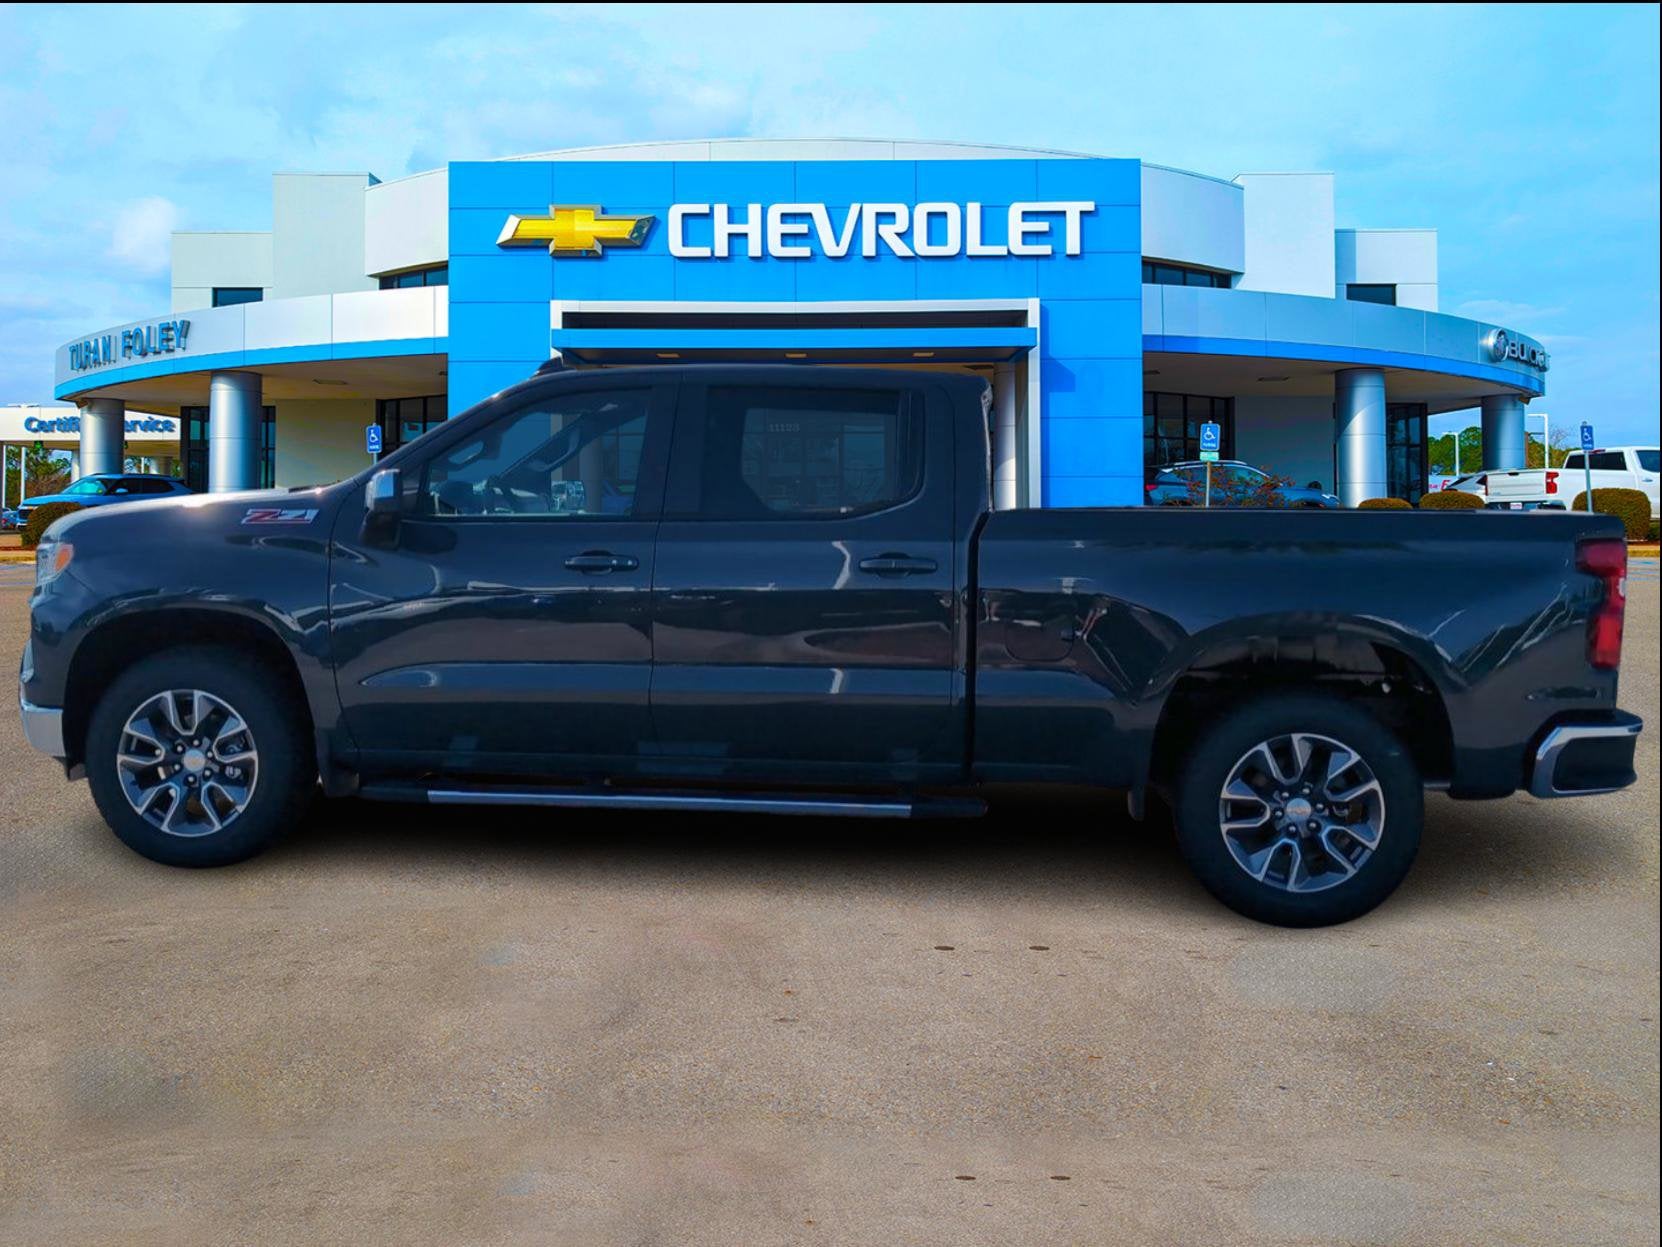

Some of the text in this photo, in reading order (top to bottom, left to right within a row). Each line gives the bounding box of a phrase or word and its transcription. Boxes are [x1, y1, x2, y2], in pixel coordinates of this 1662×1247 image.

[667, 200, 1096, 258] CHEVROLET
[69, 319, 190, 372] TURAN FOLEY
[24, 416, 176, 433] Certifi ervice
[241, 508, 320, 524] Z71
